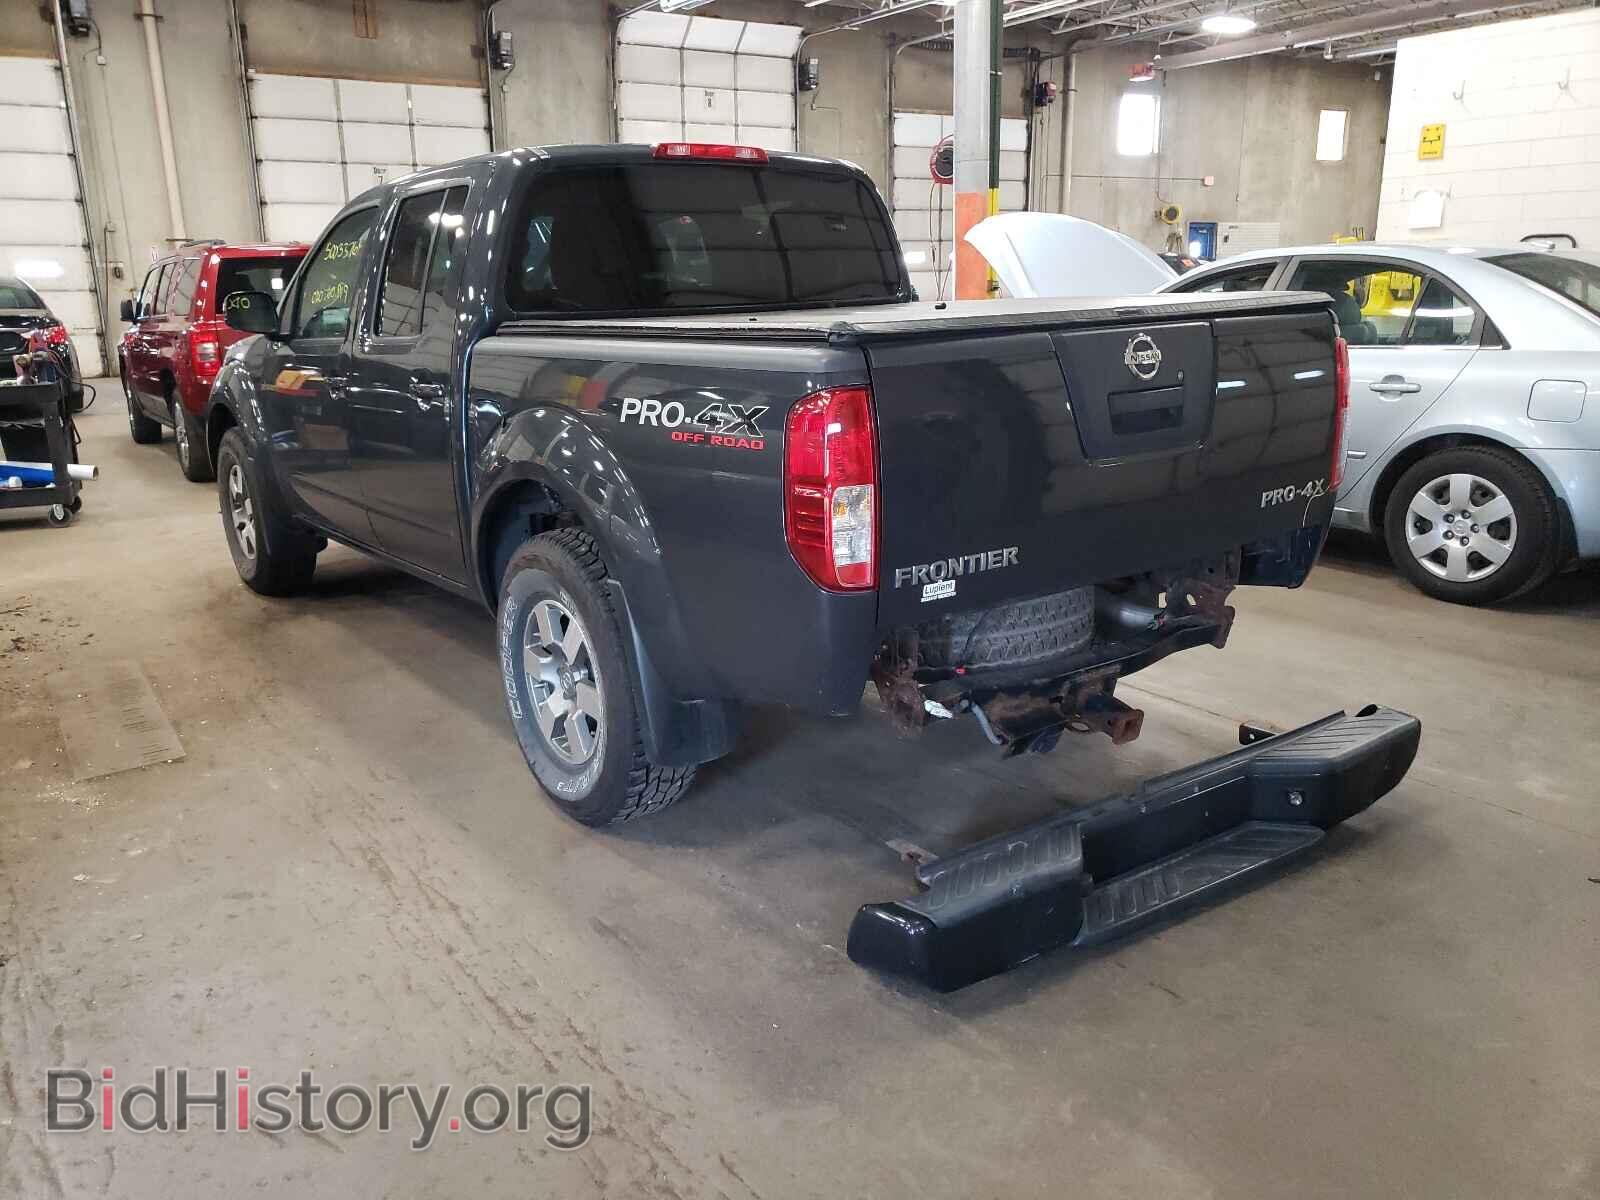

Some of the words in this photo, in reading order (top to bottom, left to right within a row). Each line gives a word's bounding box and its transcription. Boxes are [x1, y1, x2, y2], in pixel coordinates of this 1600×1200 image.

[1130, 351, 1160, 362] NISSAN
[671, 431, 705, 443] OFF
[711, 434, 765, 450] ROAD
[1260, 478, 1325, 509] PRO-4X
[895, 546, 1020, 589] FRONTIER
[924, 582, 954, 595] Lupient
[501, 596, 523, 719] COOPER
